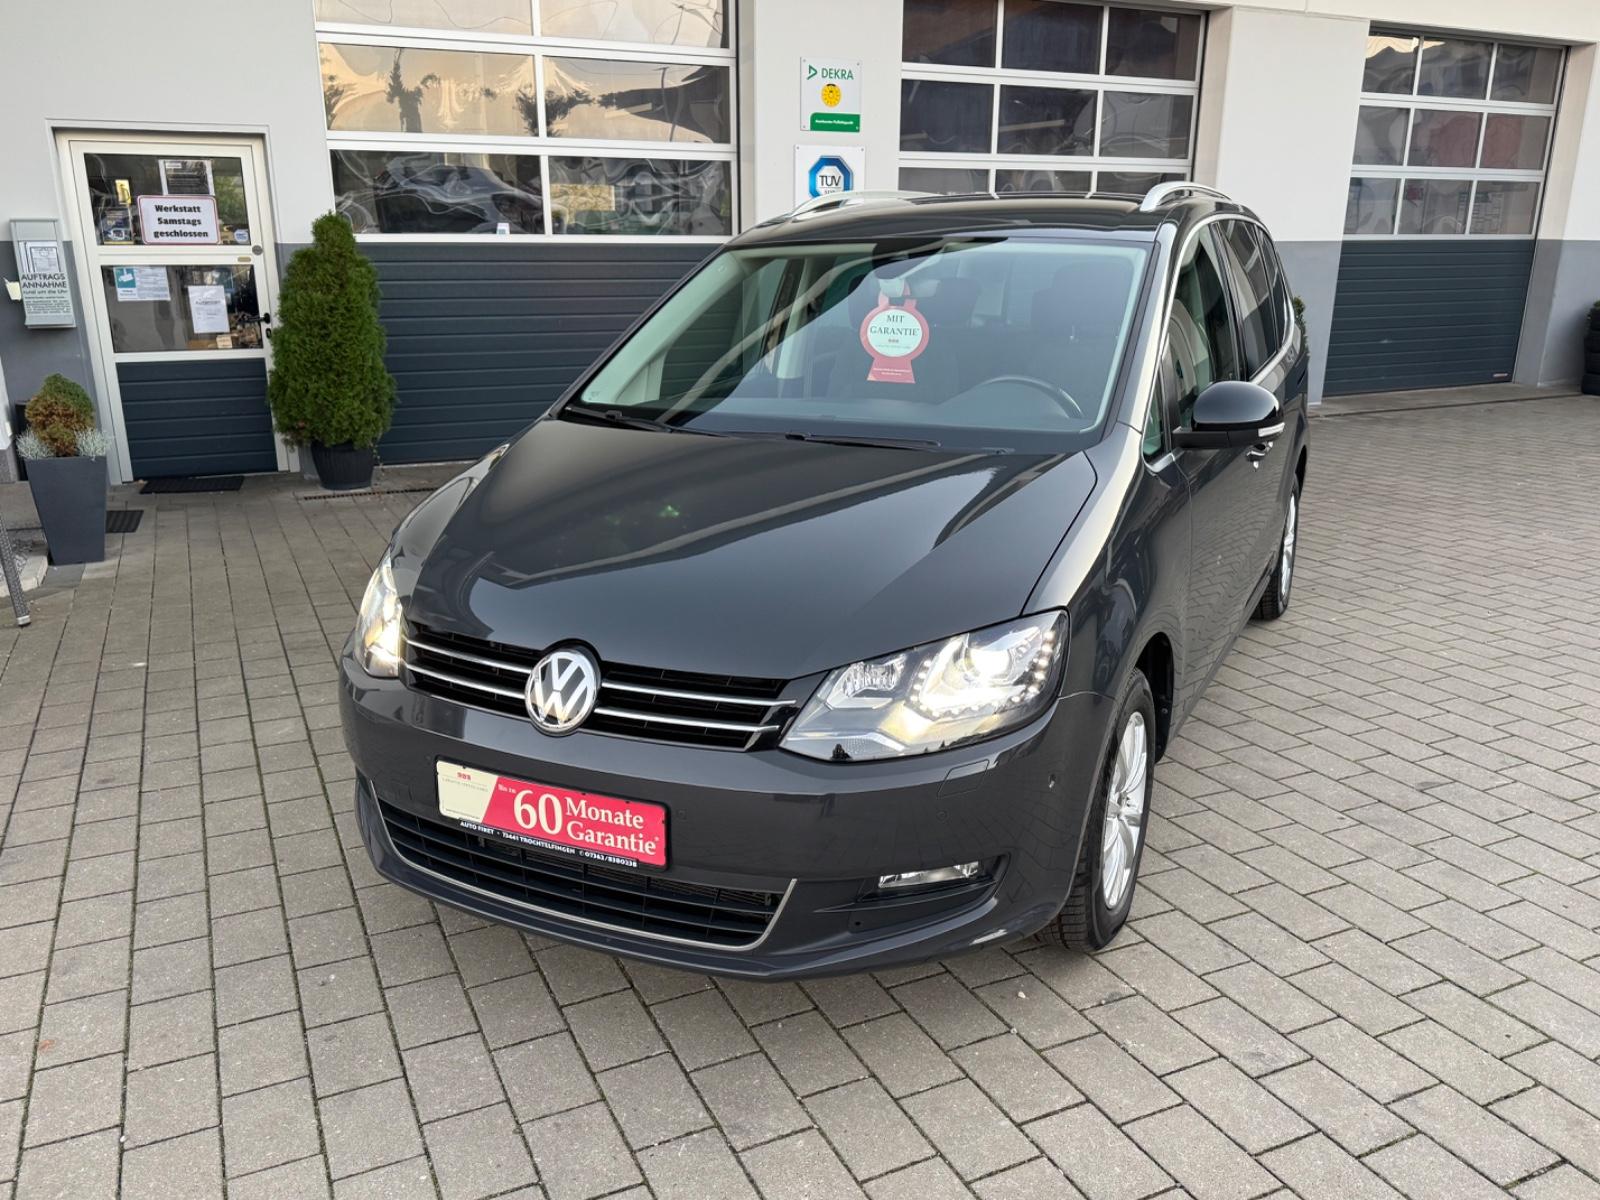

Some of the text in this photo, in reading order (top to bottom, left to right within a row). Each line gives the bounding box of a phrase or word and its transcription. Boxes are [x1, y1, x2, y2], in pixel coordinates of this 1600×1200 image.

[821, 67, 854, 80] DEKRA
[819, 175, 842, 187] TÜV
[154, 204, 202, 213] Werkstatt
[157, 217, 202, 226] Samstags
[153, 229, 209, 239] geschlossen
[21, 273, 66, 281] AUFTRAGS
[886, 315, 905, 324] MIT
[870, 326, 918, 336] GARANTIE
[513, 789, 563, 835] 60
[564, 796, 644, 829] Monate
[460, 821, 477, 831] AUTO
[519, 836, 576, 855] TROCHTELFINGEN
